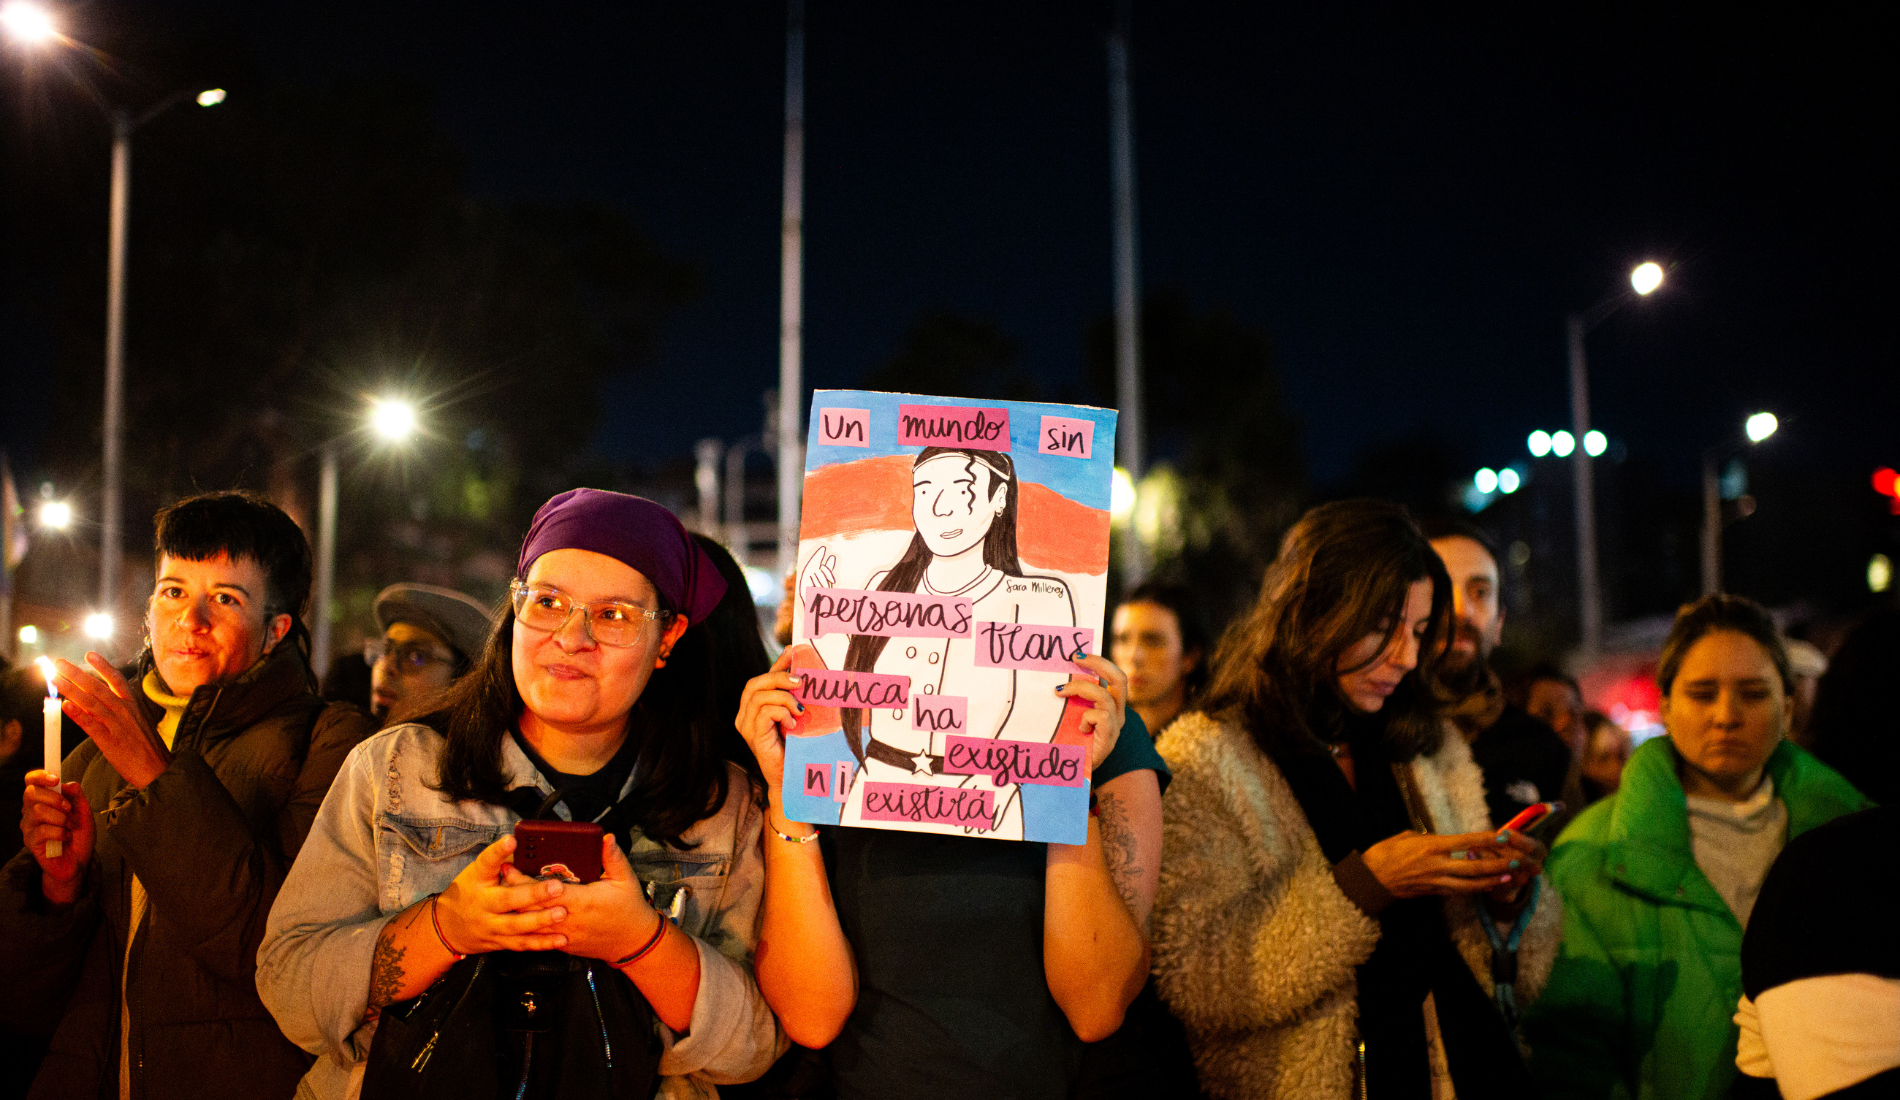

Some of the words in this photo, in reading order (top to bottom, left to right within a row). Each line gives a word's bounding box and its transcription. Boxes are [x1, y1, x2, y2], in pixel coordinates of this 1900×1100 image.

[902, 411, 1004, 442] mundo
[1047, 425, 1084, 453] sin
[1006, 579, 1027, 593] Sara
[810, 593, 972, 635] personas
[981, 621, 1089, 664] trans
[800, 673, 907, 705] nunca
[916, 698, 961, 729] ha
[949, 743, 1080, 786] existido
[866, 787, 994, 821] existirá
